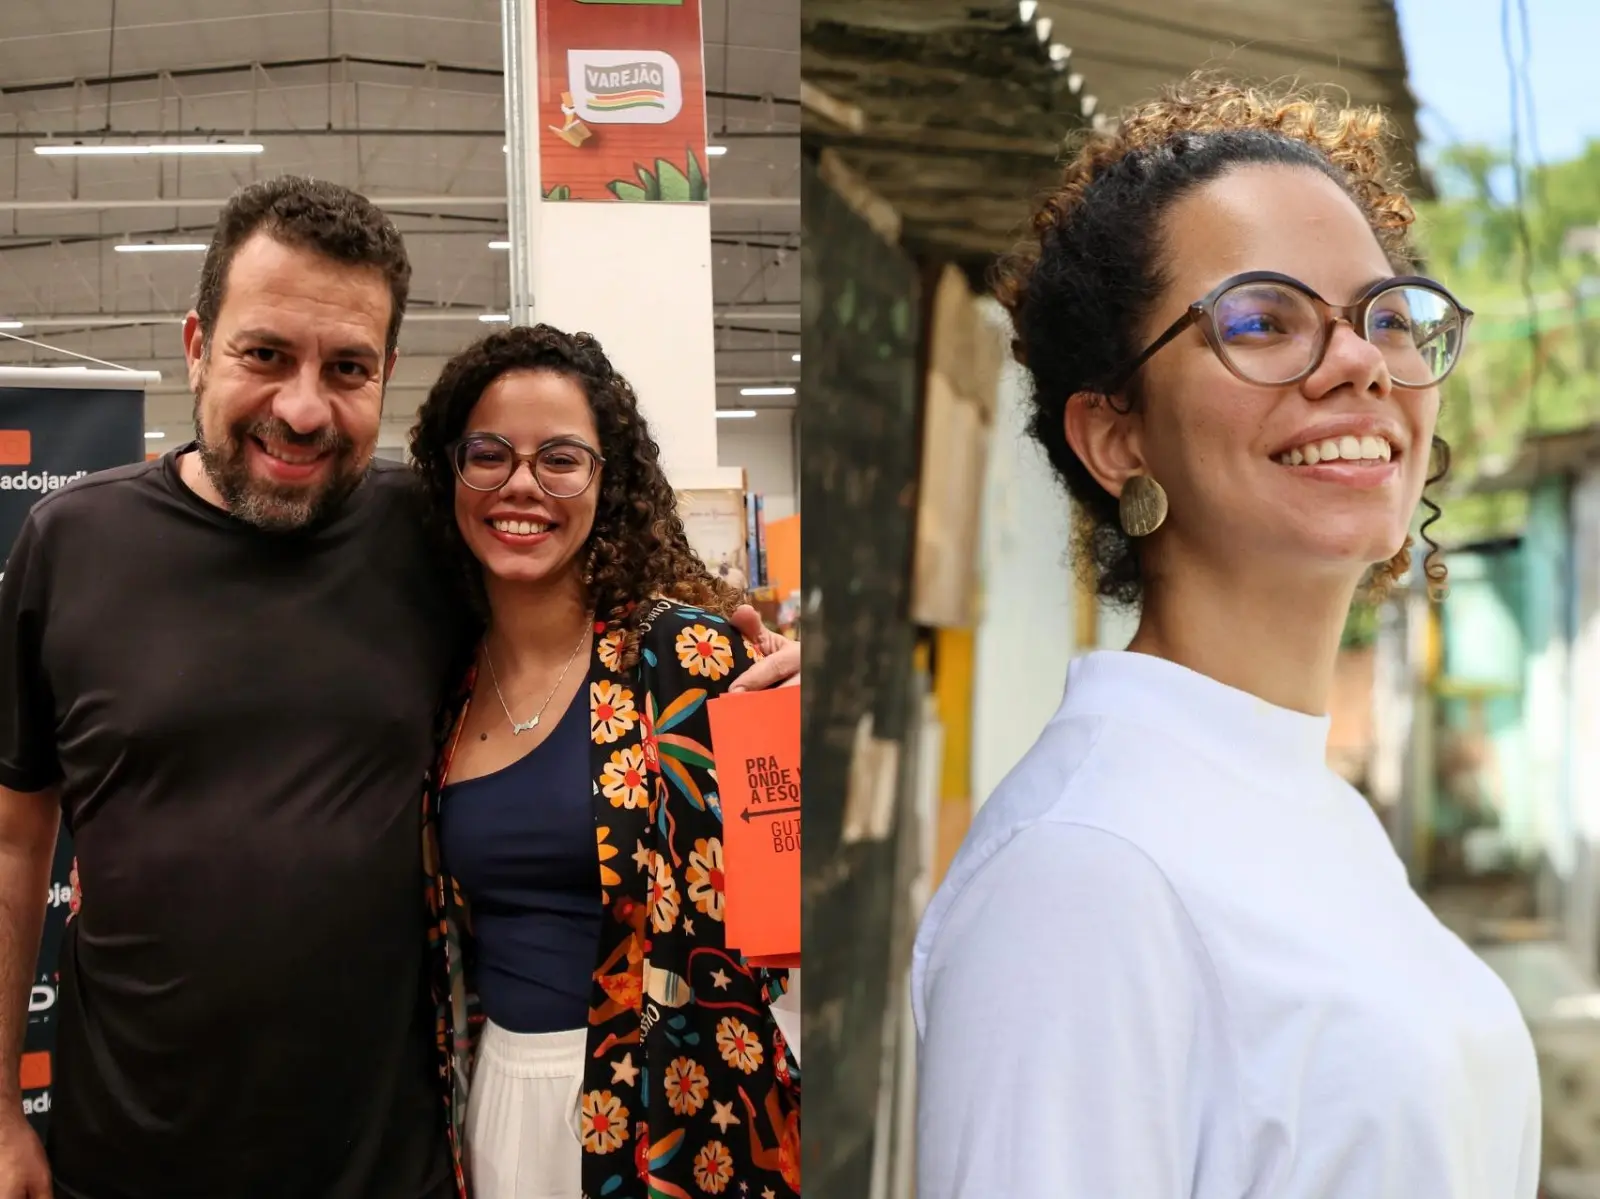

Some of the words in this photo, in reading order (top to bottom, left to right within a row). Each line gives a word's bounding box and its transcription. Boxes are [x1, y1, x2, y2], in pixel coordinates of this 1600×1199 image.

[586, 63, 662, 88] VAREJÃO
[745, 755, 779, 774] PRA
[748, 768, 792, 789] ONDE
[751, 789, 762, 804] A
[766, 783, 800, 803] ESQ
[22, 1091, 52, 1115] ad
